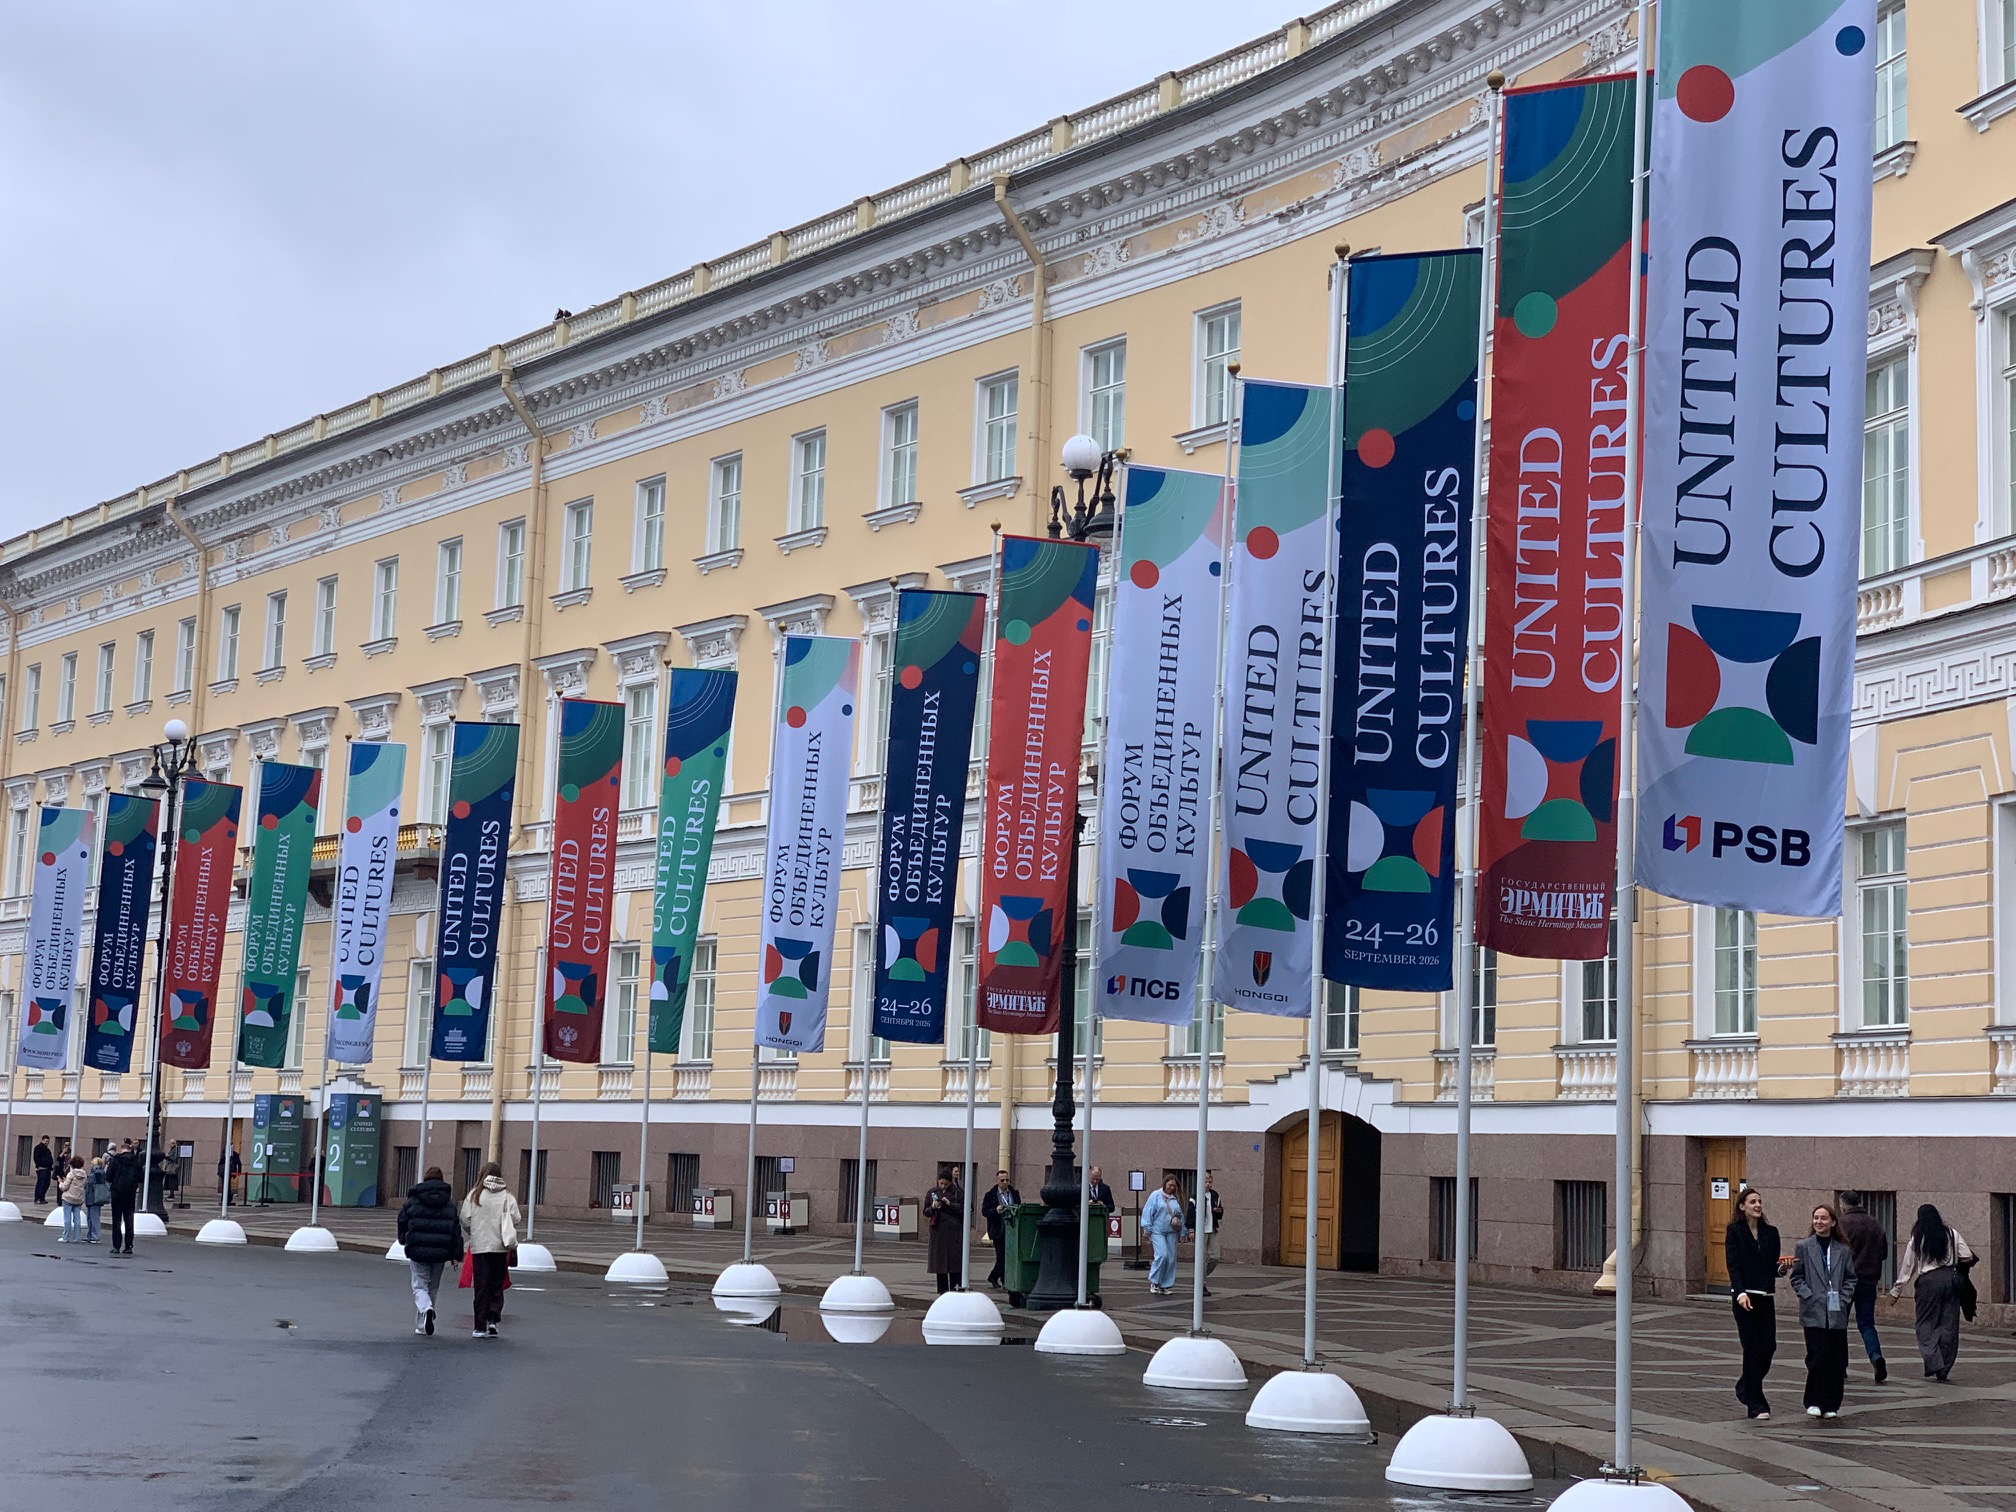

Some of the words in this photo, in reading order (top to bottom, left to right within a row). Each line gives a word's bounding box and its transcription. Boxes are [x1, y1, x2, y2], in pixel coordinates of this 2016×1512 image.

[1769, 125, 1841, 579] CULTURES
[1673, 236, 1742, 570] UNITED
[1511, 427, 1564, 691] UNITED
[1581, 333, 1629, 693] CULTURES
[1354, 542, 1400, 766] UNITED
[1416, 466, 1460, 768] CULTURES
[1015, 648, 1052, 881] ОБЪЕДИНЕННЫХ
[1147, 593, 1183, 854] ОБЪЕДИНЕННЫХ
[1234, 624, 1280, 817] UNITED
[789, 730, 822, 927] ОБЪЕДИНЕННЫХ
[904, 690, 941, 903] ОБЪЕДИНЕННЫХ
[994, 783, 1014, 879] ФОРУМ
[1039, 762, 1066, 881] КУЛЬТУР
[1119, 742, 1144, 851] ФОРУМ
[1175, 721, 1202, 857] КУЛЬТУР
[468, 820, 500, 959] CULTURES
[582, 807, 610, 954] CULTURES
[653, 816, 677, 932] UNITED
[669, 779, 711, 936] CULTURES
[769, 844, 790, 924] ФОРУМ
[809, 827, 833, 928] КУЛЬТУР
[888, 814, 906, 902] ФОРУМ
[926, 794, 951, 905] КУЛЬТУР
[1501, 877, 1606, 890] ГОСУДАРСТВЕННЫЙ
[1712, 820, 1812, 868] PSB
[246, 914, 264, 972] ФОРУМ
[277, 903, 296, 977] КУЛЬТУР
[339, 865, 359, 964] UNITED
[357, 835, 389, 967] CULTURES
[443, 852, 468, 958] UNITED
[553, 839, 580, 950] UNITED
[1500, 886, 1605, 919] ЭРМИТАЖ
[1500, 914, 1513, 924] The
[1514, 917, 1536, 927] State
[1538, 920, 1575, 930] Hermitage
[1576, 921, 1603, 929] Museum
[33, 939, 46, 989] ФОРУМ
[59, 928, 75, 991] КУЛЬТУР
[99, 932, 114, 986] ФОРУМ
[125, 923, 140, 990] КУЛЬТУР
[173, 924, 189, 980] ФОРУМ
[202, 913, 220, 983] КУЛЬТУР
[1130, 977, 1180, 1000] ПСБ
[1234, 988, 1289, 1003] HONGQI
[1344, 949, 1416, 965] SEPTEMBER
[1419, 955, 1440, 965] 2026
[765, 1036, 803, 1047] HONGQI
[880, 1016, 914, 1026] СЕНТЯБРЯ
[915, 1019, 931, 1028] 2026
[986, 992, 1046, 1012] ЭРМИТАЖ
[253, 1142, 263, 1168] 2
[328, 1144, 340, 1171] 2
